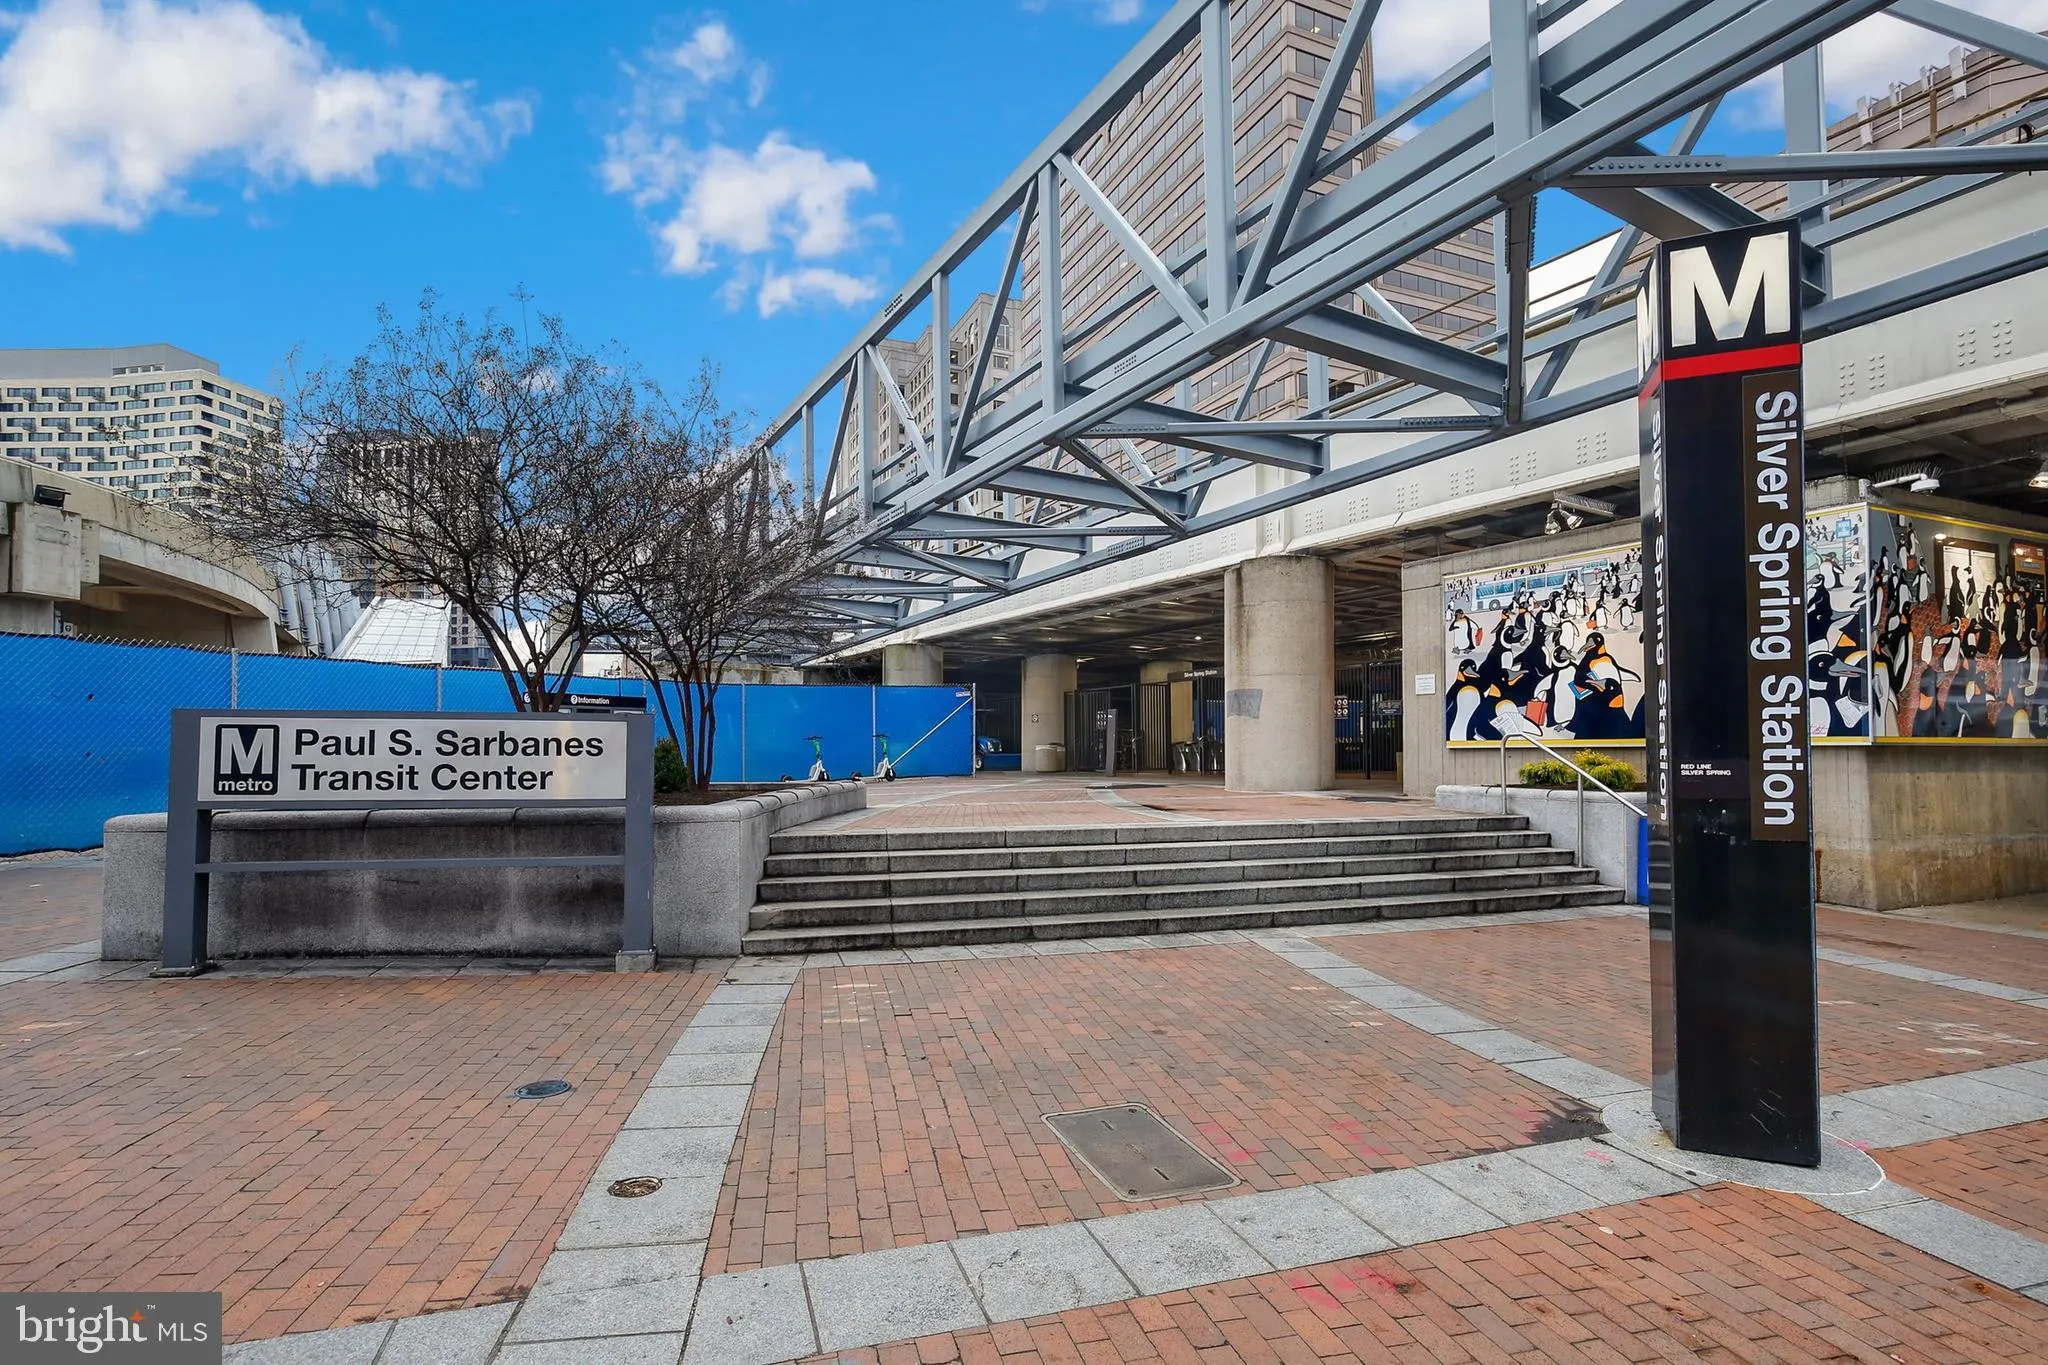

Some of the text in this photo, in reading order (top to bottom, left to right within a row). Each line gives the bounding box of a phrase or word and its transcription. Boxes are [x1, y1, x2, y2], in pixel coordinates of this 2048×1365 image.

[1669, 230, 1791, 348] M
[1636, 257, 1659, 385] M
[1652, 410, 1669, 821] Silver Spring Station
[1750, 391, 1804, 826] Silver Spring Station
[577, 696, 610, 705] Information
[219, 727, 273, 775] M
[294, 728, 605, 757] Paul S. Sarbanes
[218, 777, 274, 792] metro
[291, 763, 554, 791] Transit Center
